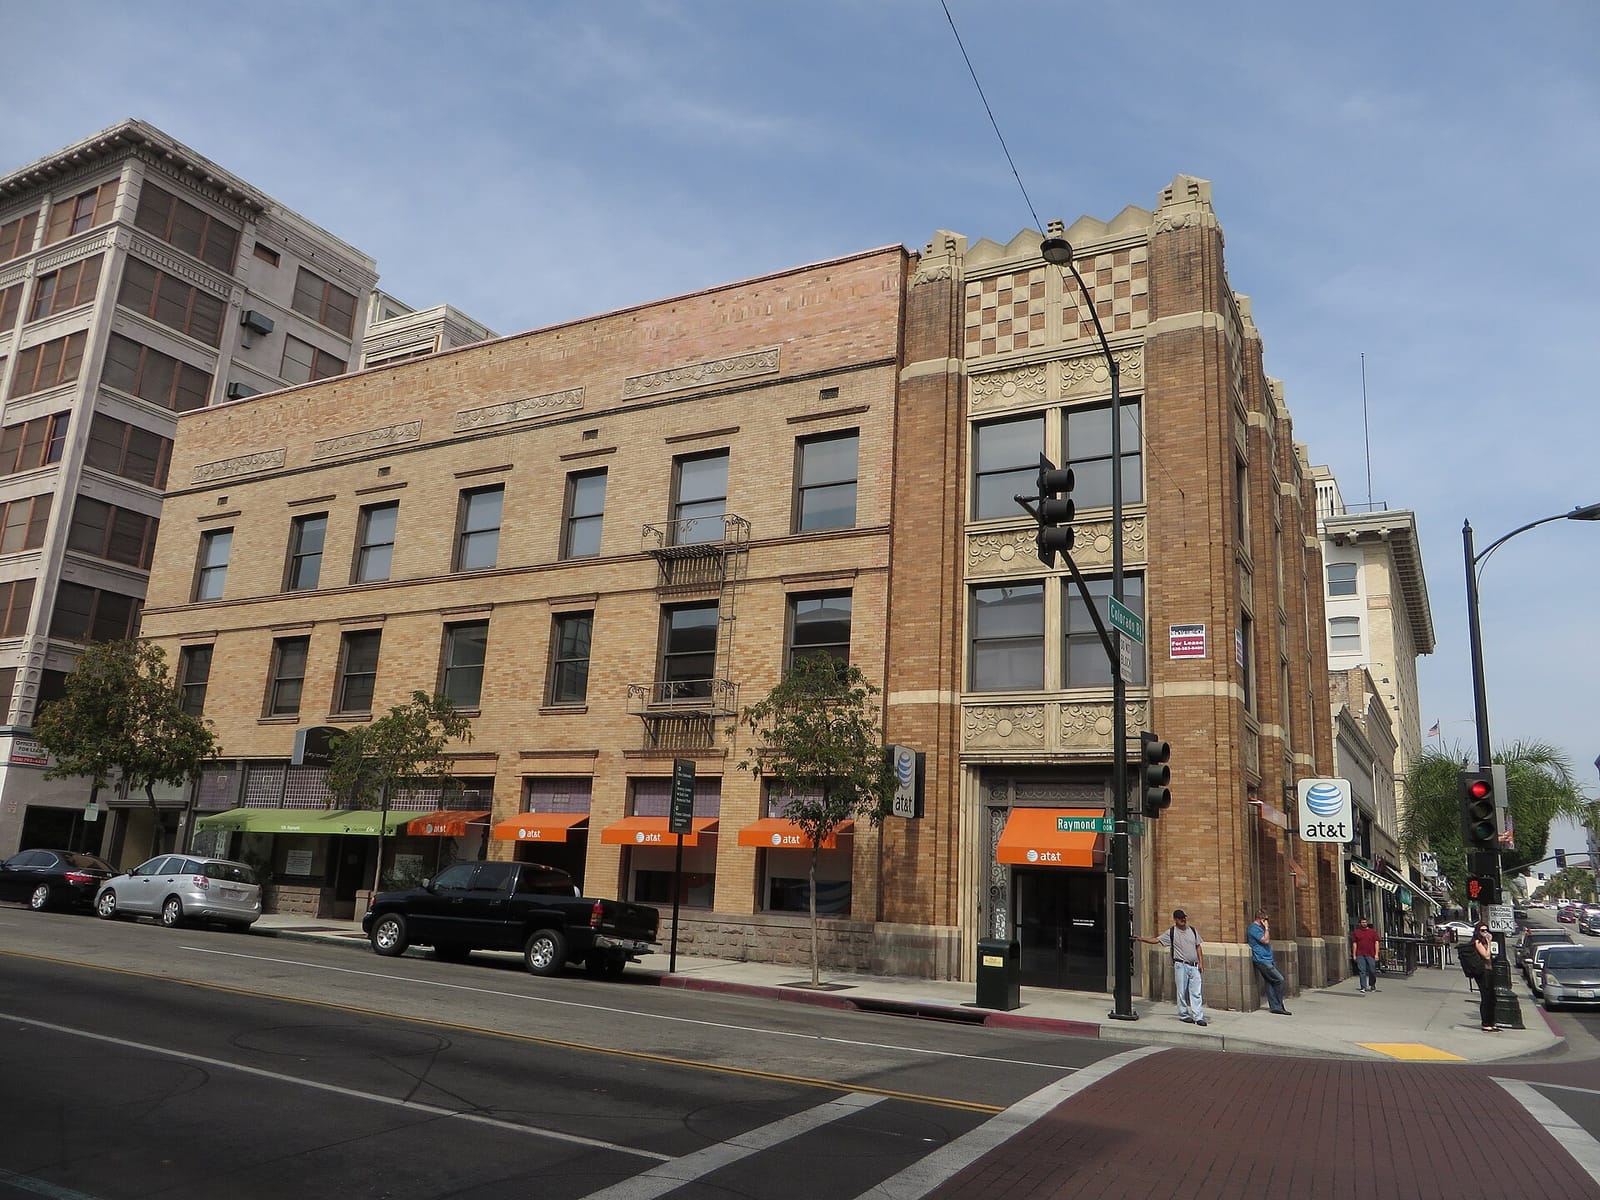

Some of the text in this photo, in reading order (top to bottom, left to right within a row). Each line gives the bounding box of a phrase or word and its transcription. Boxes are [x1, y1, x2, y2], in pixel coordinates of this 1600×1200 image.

[1110, 604, 1135, 633] Colorado
[895, 794, 912, 814] at&t
[1057, 818, 1096, 832] Raymond
[1306, 821, 1346, 838] at&t
[527, 830, 541, 838] at&t
[645, 833, 661, 841] at&t
[782, 835, 800, 844] at&t
[1040, 851, 1062, 861] at&t
[1491, 920, 1501, 929] OK
